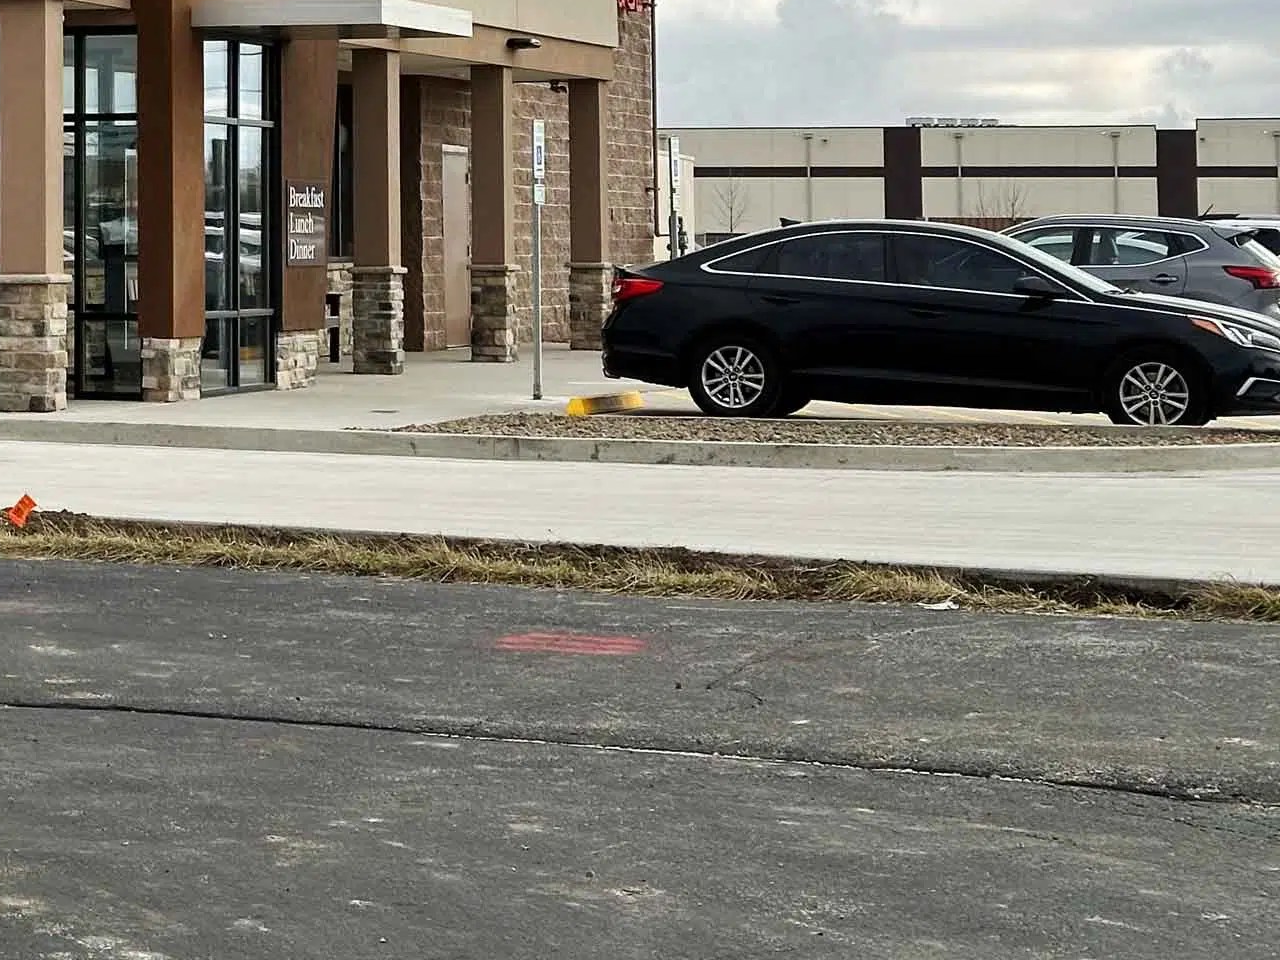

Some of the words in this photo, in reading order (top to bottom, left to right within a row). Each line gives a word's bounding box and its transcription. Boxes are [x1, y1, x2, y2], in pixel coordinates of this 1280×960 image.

[289, 186, 324, 208] Breakfast
[289, 212, 314, 234] Lunch
[289, 238, 315, 260] Dinner
